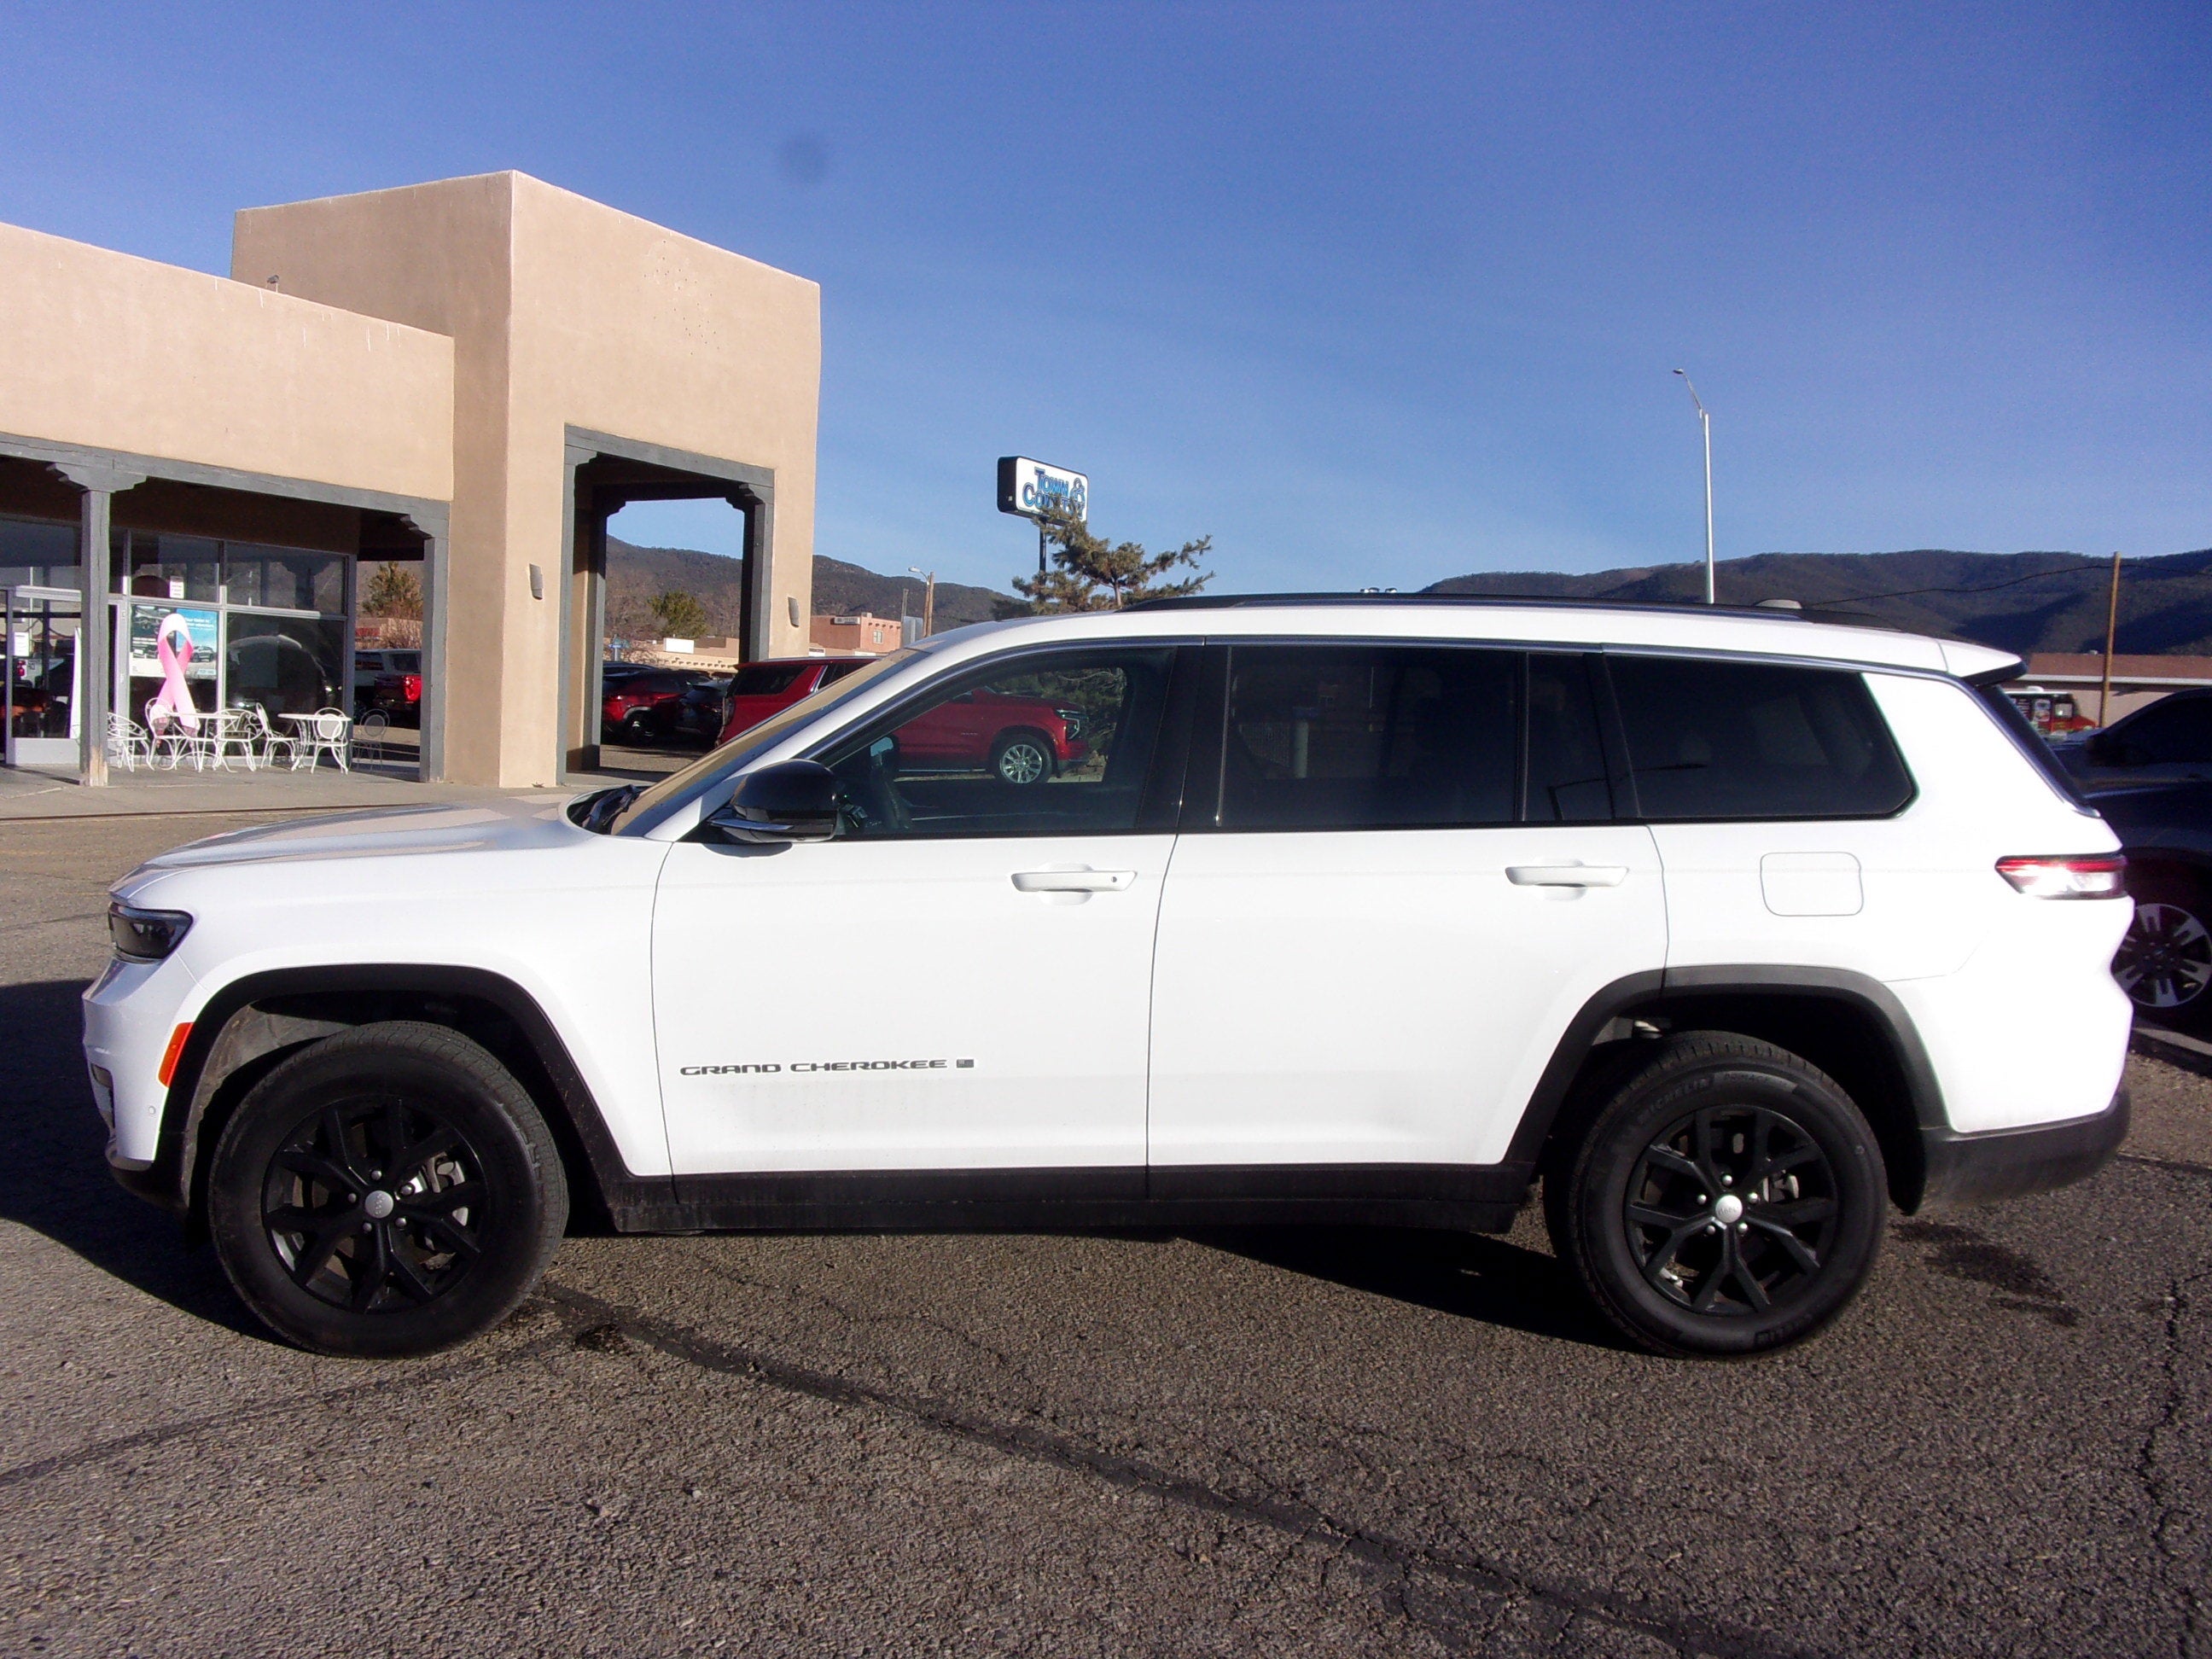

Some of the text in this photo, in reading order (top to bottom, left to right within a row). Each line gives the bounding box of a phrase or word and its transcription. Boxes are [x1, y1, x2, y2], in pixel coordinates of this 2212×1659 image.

[1034, 467, 1069, 497] TOWN
[1022, 482, 1086, 520] COUTY
[680, 1059, 948, 1076] GRAND CHEROKEE
